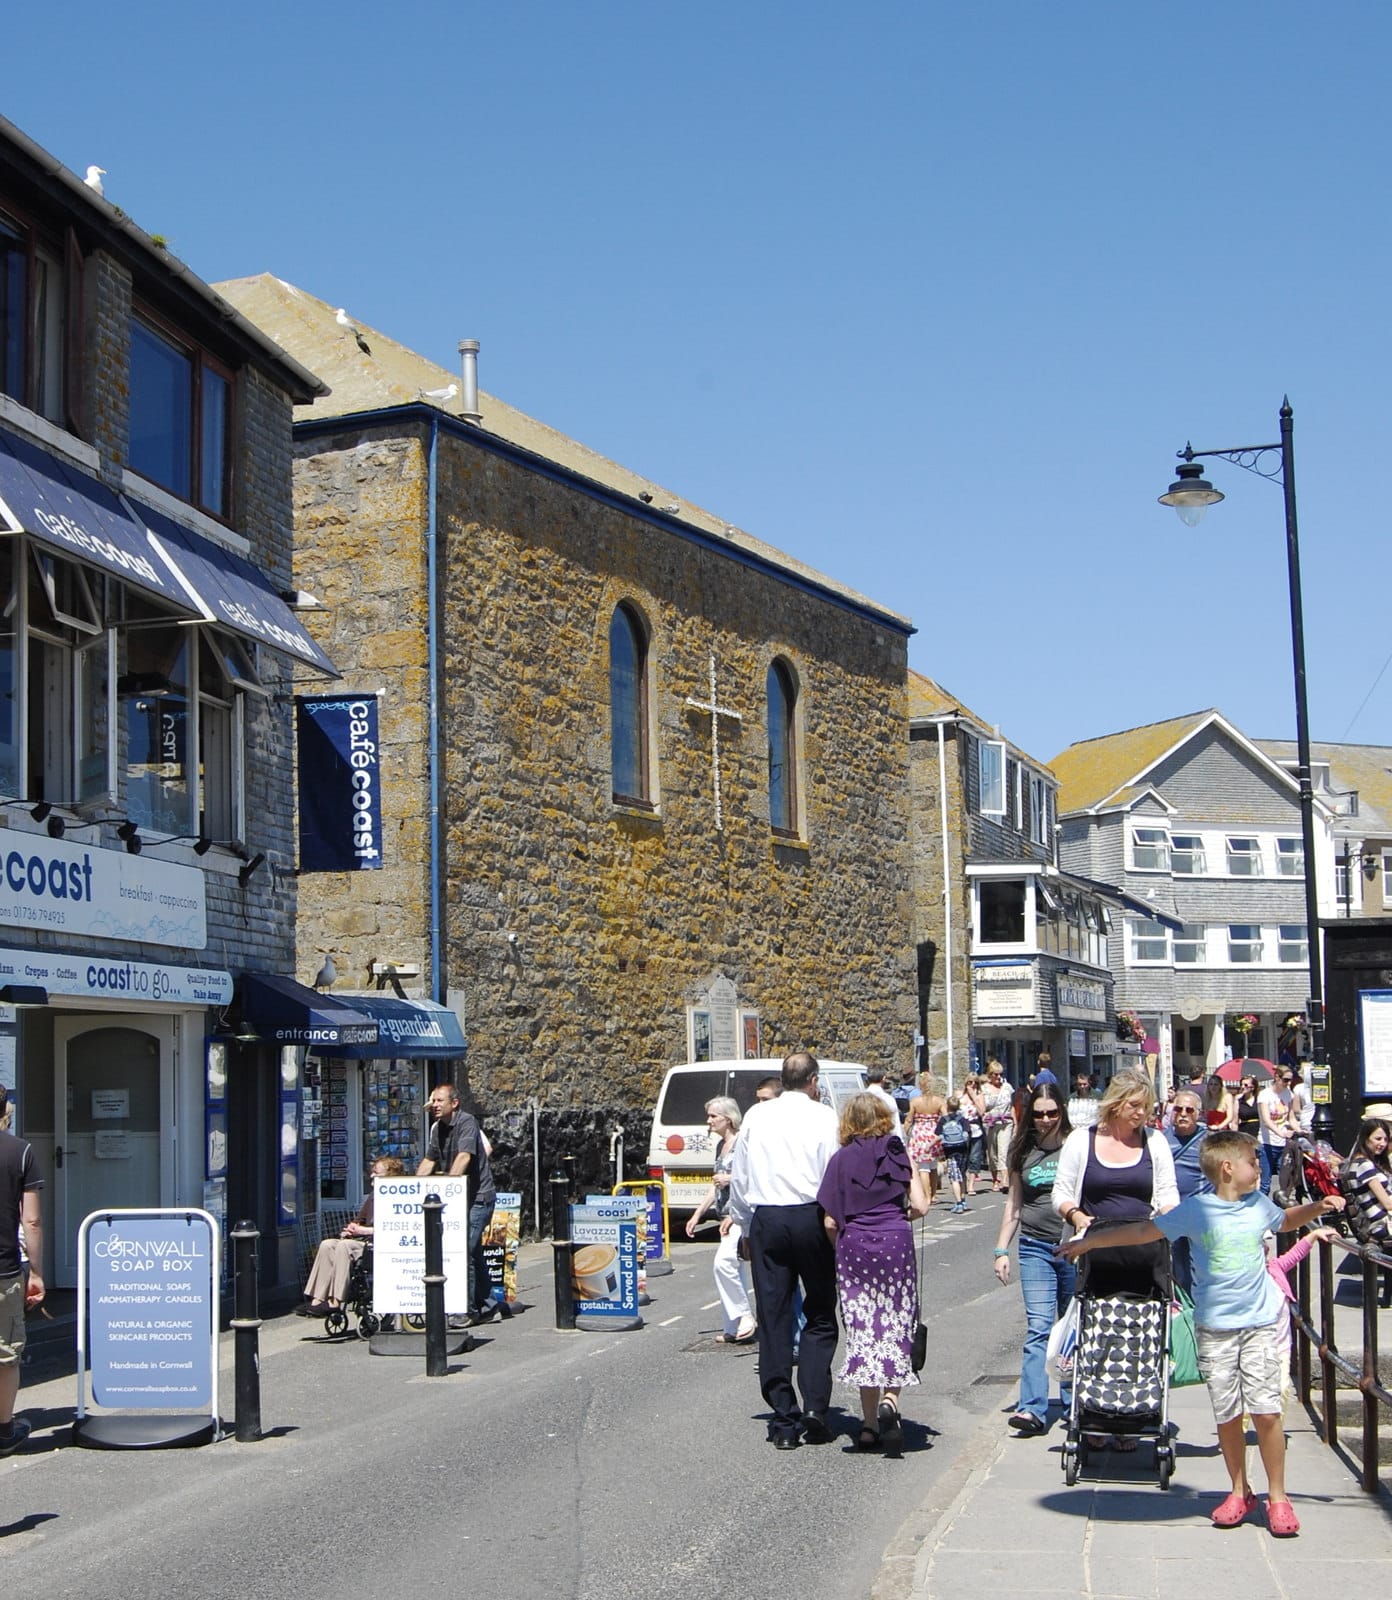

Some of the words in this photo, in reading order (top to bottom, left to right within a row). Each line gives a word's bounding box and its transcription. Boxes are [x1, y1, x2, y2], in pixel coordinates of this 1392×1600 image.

[120, 881, 153, 903] breakfast
[159, 894, 198, 911] cappuccino
[13, 906, 37, 921] 01736
[38, 909, 65, 924] 794925
[25, 965, 49, 979] Crepes
[56, 968, 78, 979] Coffee
[187, 973, 207, 986] Quality
[208, 975, 221, 985] Food
[221, 977, 227, 985] to
[194, 989, 207, 999] Take
[207, 990, 221, 1002] Away
[276, 1027, 338, 1041] entrance
[1028, 1166, 1057, 1180] Supe
[379, 1182, 420, 1195] coast
[425, 1183, 440, 1195] to
[445, 1183, 462, 1197] go
[597, 1208, 629, 1217] coast
[382, 1221, 409, 1231] FISH
[412, 1222, 422, 1231] &
[574, 1225, 616, 1235] Lavazza
[94, 1236, 205, 1258] CORNWALL
[399, 1235, 424, 1246] £4.
[621, 1230, 636, 1253] day
[110, 1260, 154, 1272] SOAP
[162, 1260, 192, 1272] BOX
[621, 1254, 633, 1268] all
[109, 1282, 163, 1291] TRADITIONAL
[166, 1282, 192, 1291] SOAPS
[622, 1271, 634, 1310] Served
[98, 1295, 161, 1304] AROMATHERAPY
[165, 1295, 202, 1304] CANDLES
[108, 1320, 146, 1329] NATURAL
[146, 1320, 153, 1329] &
[154, 1320, 193, 1329] ORGANIC
[108, 1333, 148, 1342] SKINCARE
[149, 1333, 193, 1342] PRODUCTS
[109, 1361, 149, 1370] Handmade
[150, 1361, 158, 1370] in
[159, 1361, 193, 1370] Cornwall
[105, 1384, 198, 1394] www.cornwallsoapbox.co.uk
